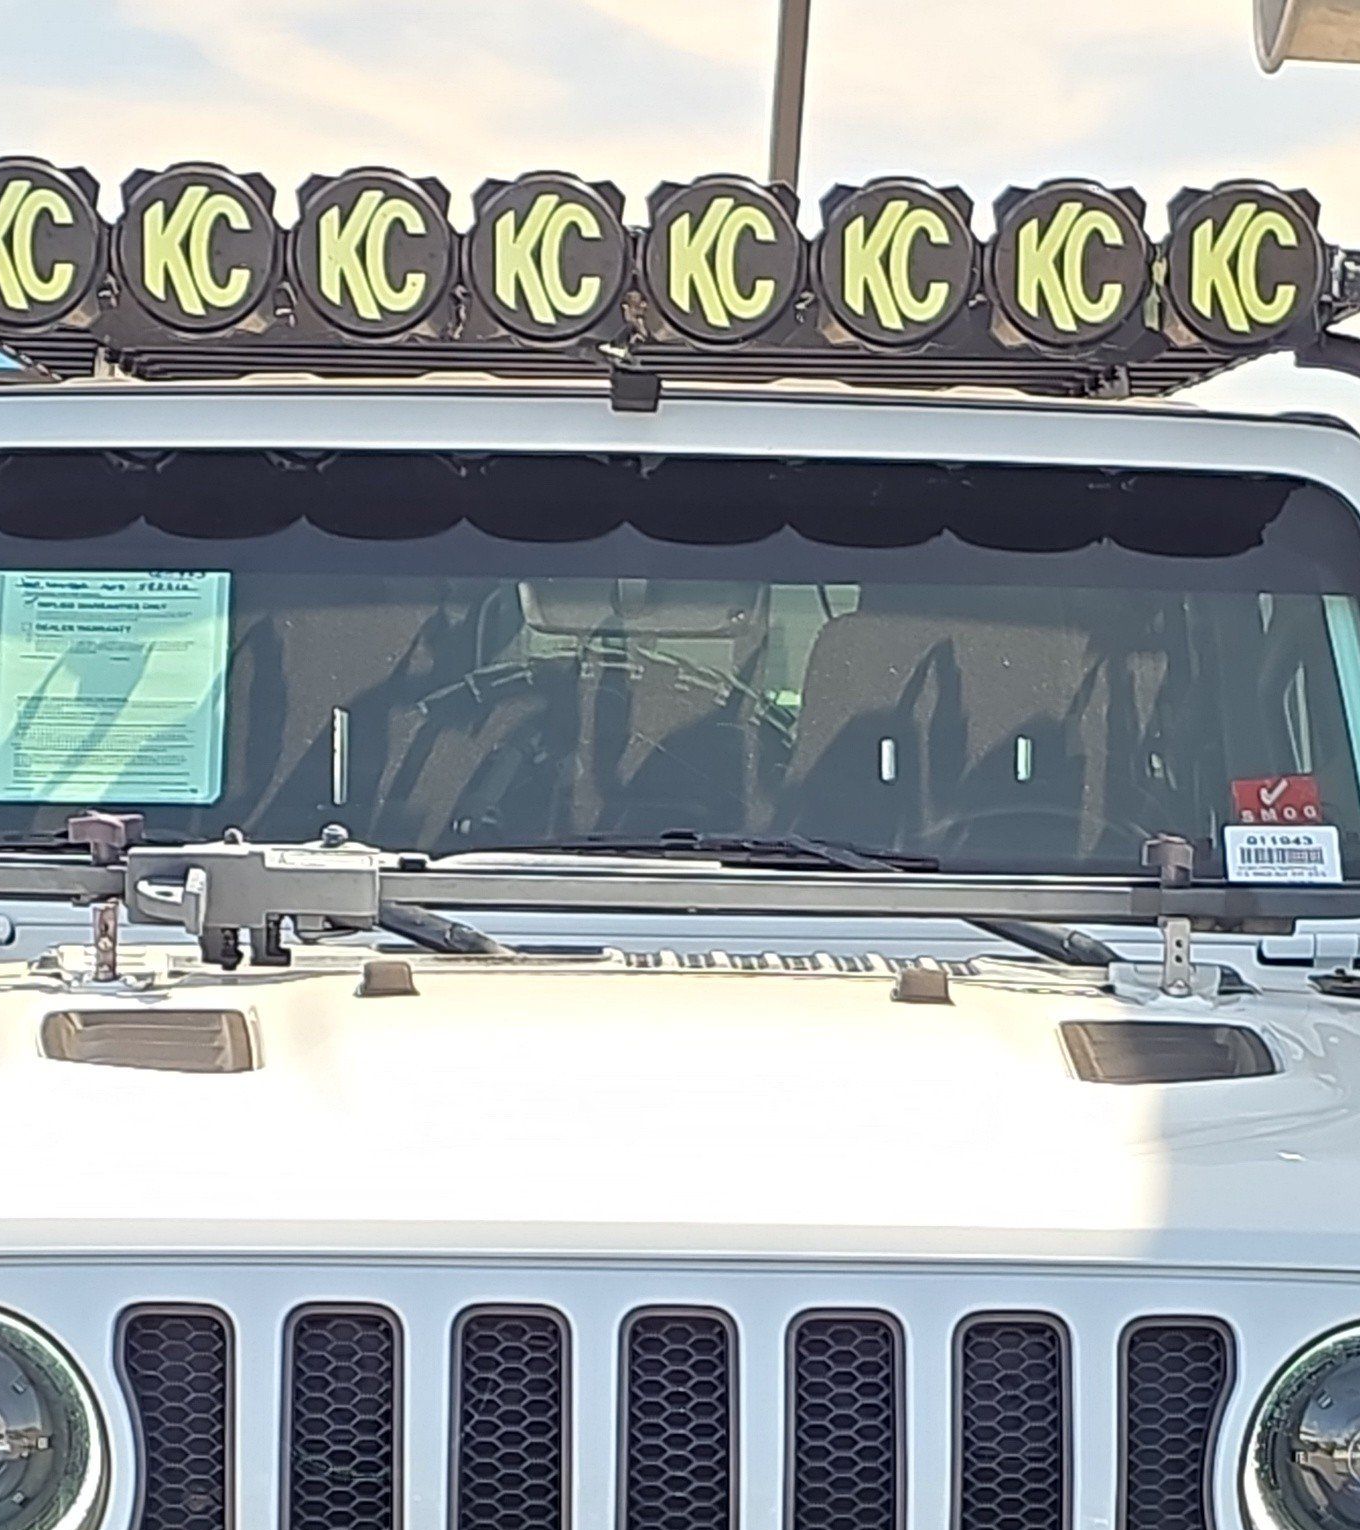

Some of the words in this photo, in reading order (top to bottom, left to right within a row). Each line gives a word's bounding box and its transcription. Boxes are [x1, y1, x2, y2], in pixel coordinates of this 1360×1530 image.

[143, 187, 248, 316] KC
[319, 192, 425, 320] KC
[495, 195, 599, 323] KC
[668, 198, 775, 328] KC
[843, 200, 949, 331] KC
[1017, 202, 1123, 332] KC
[1191, 203, 1297, 332] KC
